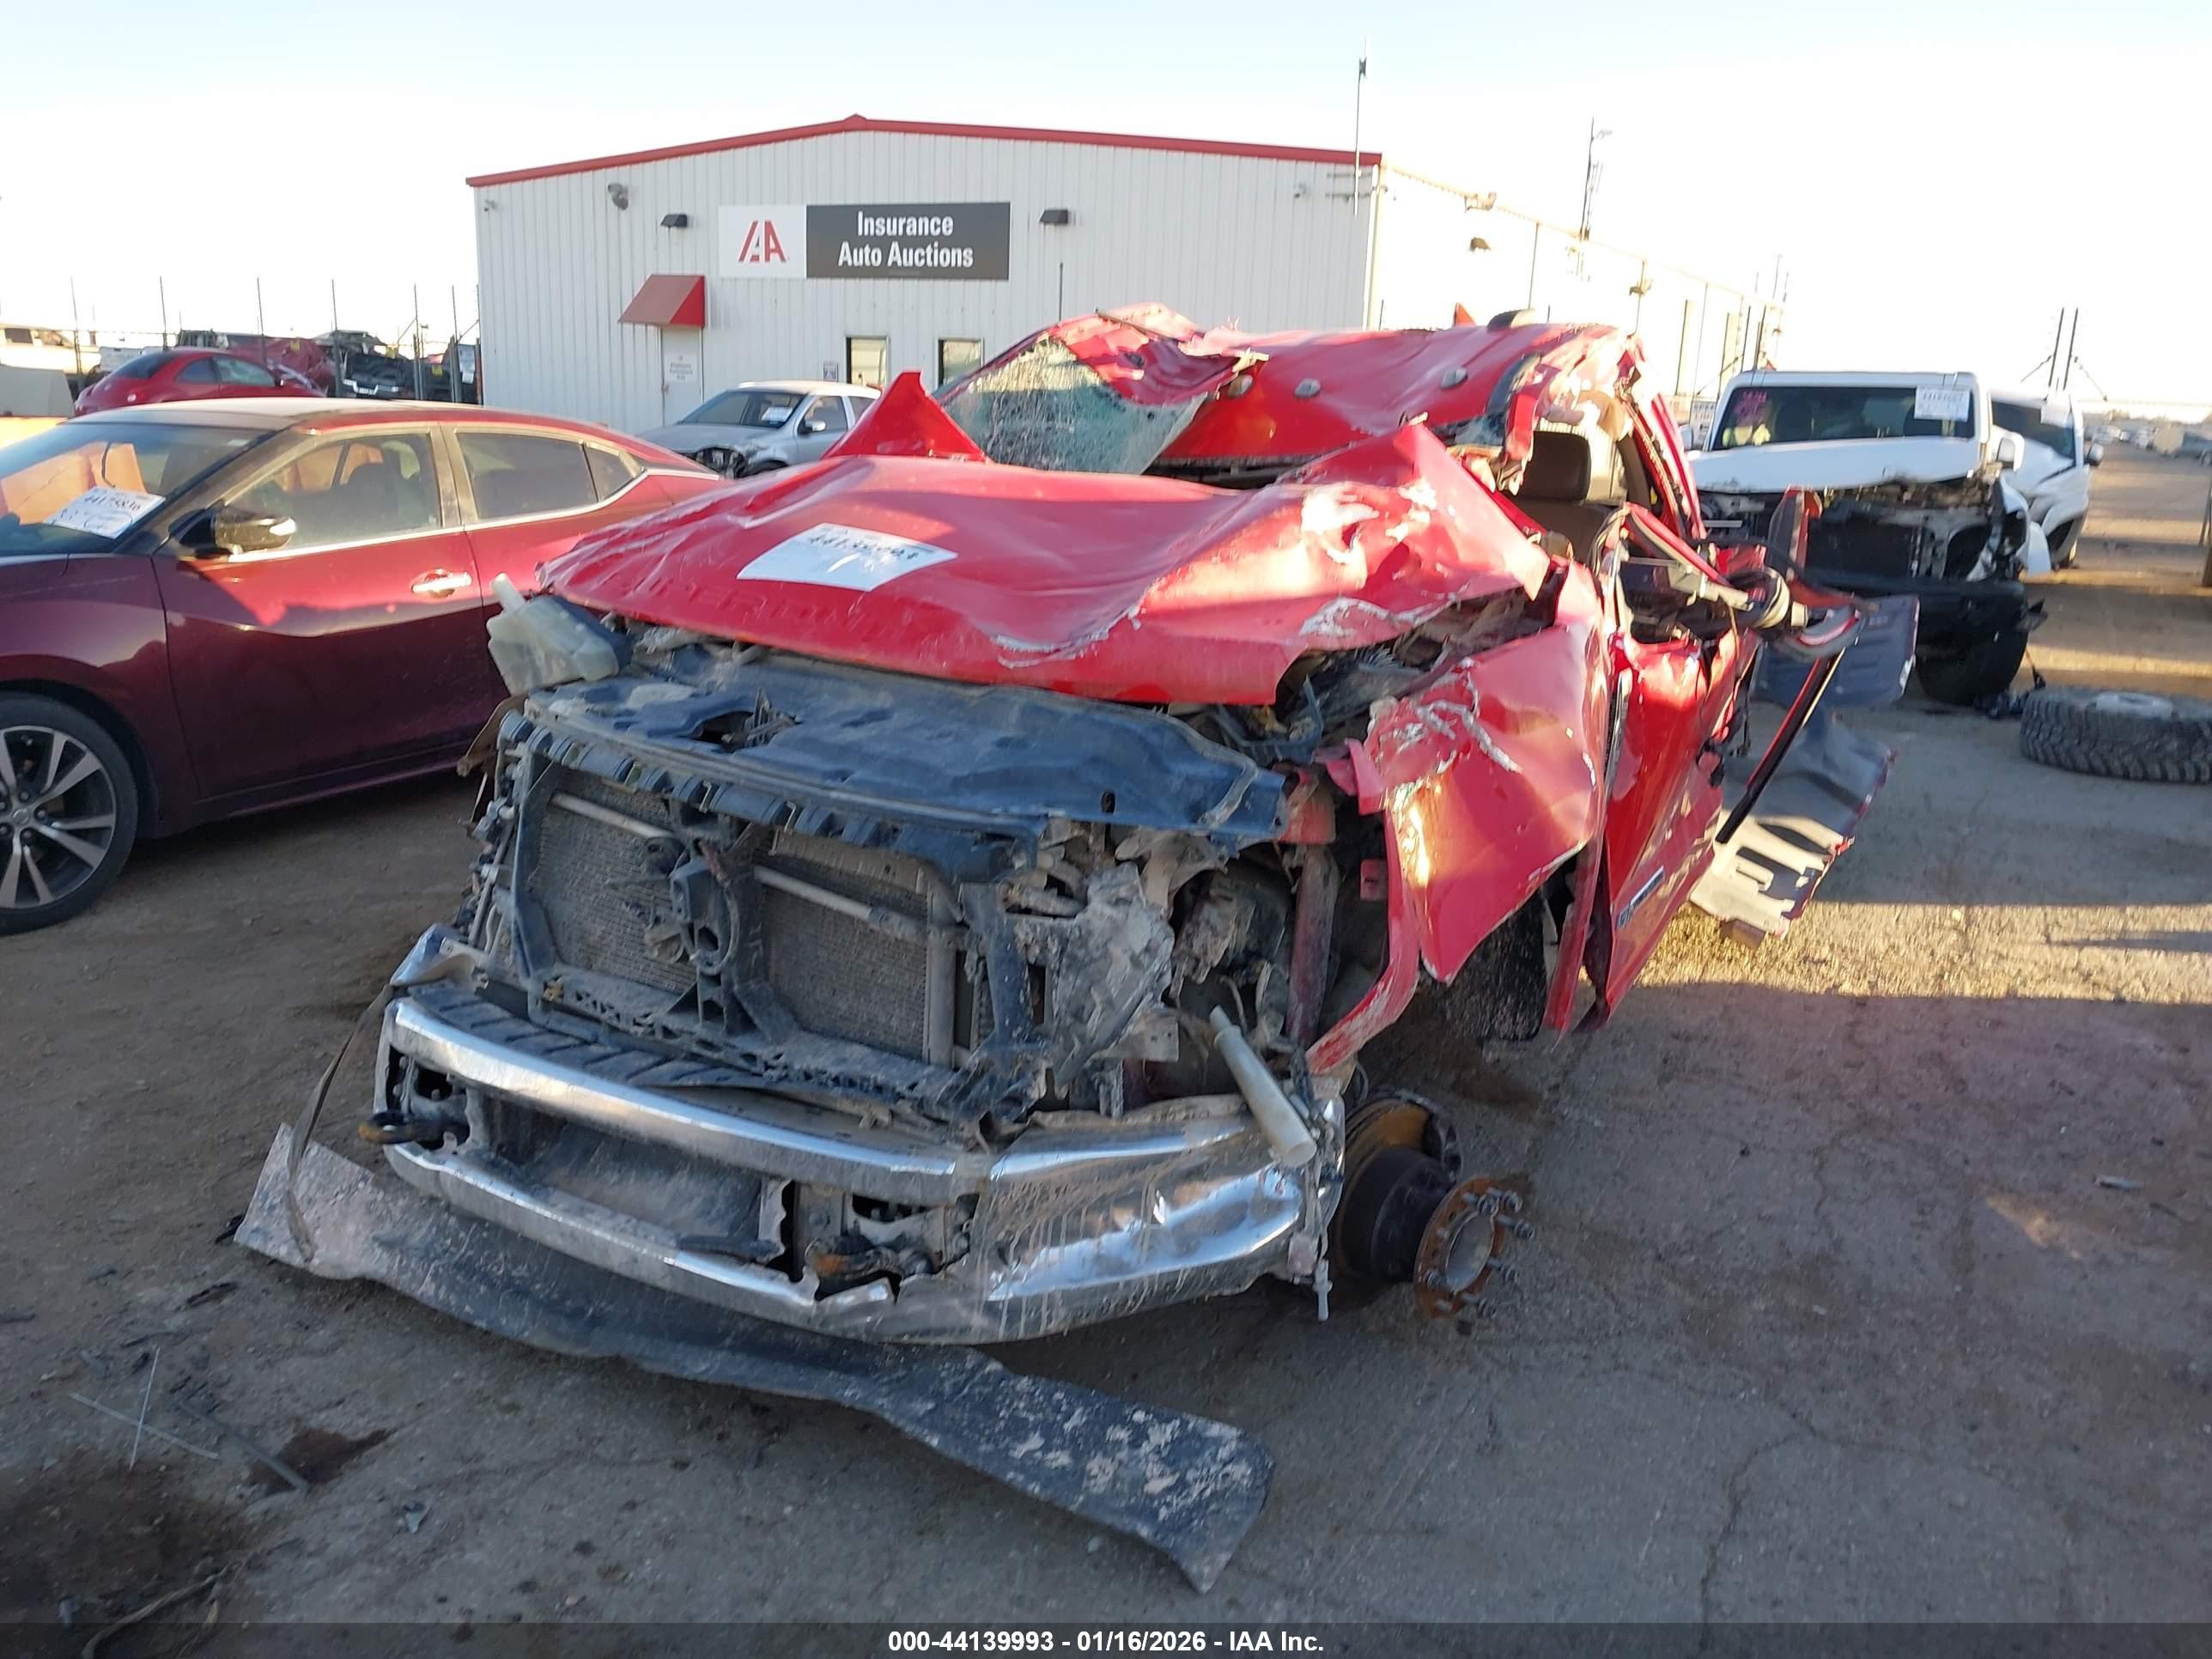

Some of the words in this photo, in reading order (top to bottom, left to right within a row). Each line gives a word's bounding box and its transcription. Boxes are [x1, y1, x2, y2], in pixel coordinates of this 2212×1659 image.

[857, 210, 954, 237] Insurance
[838, 241, 882, 267] Auto
[887, 241, 975, 268] Auctions
